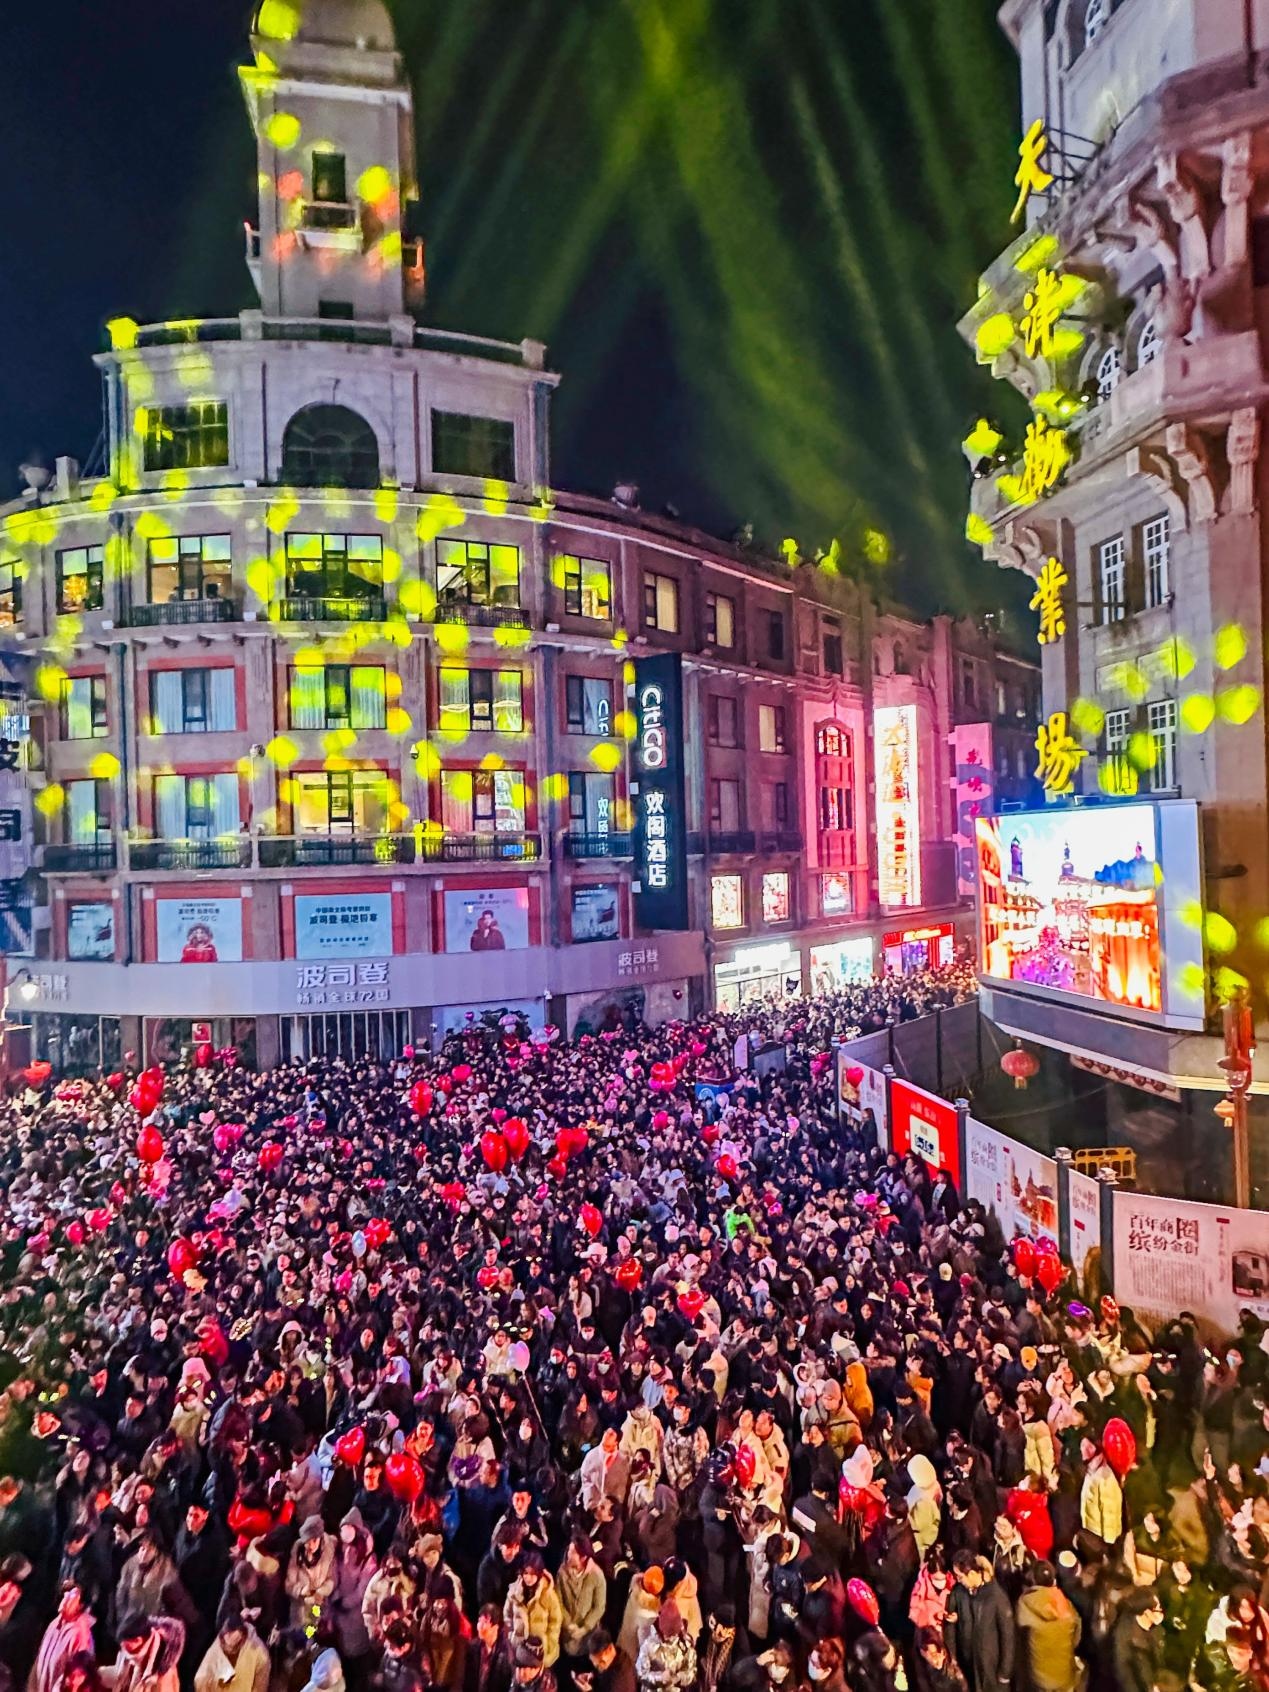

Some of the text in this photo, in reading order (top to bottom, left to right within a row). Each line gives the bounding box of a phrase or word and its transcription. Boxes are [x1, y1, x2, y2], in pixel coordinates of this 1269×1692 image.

[646, 791, 668, 887] 欢阁酒店
[618, 949, 659, 968] 波司登
[296, 962, 388, 988] 波司登
[1129, 1214, 1199, 1243] 百年商圈
[1128, 1230, 1199, 1257] 缤纷金街
